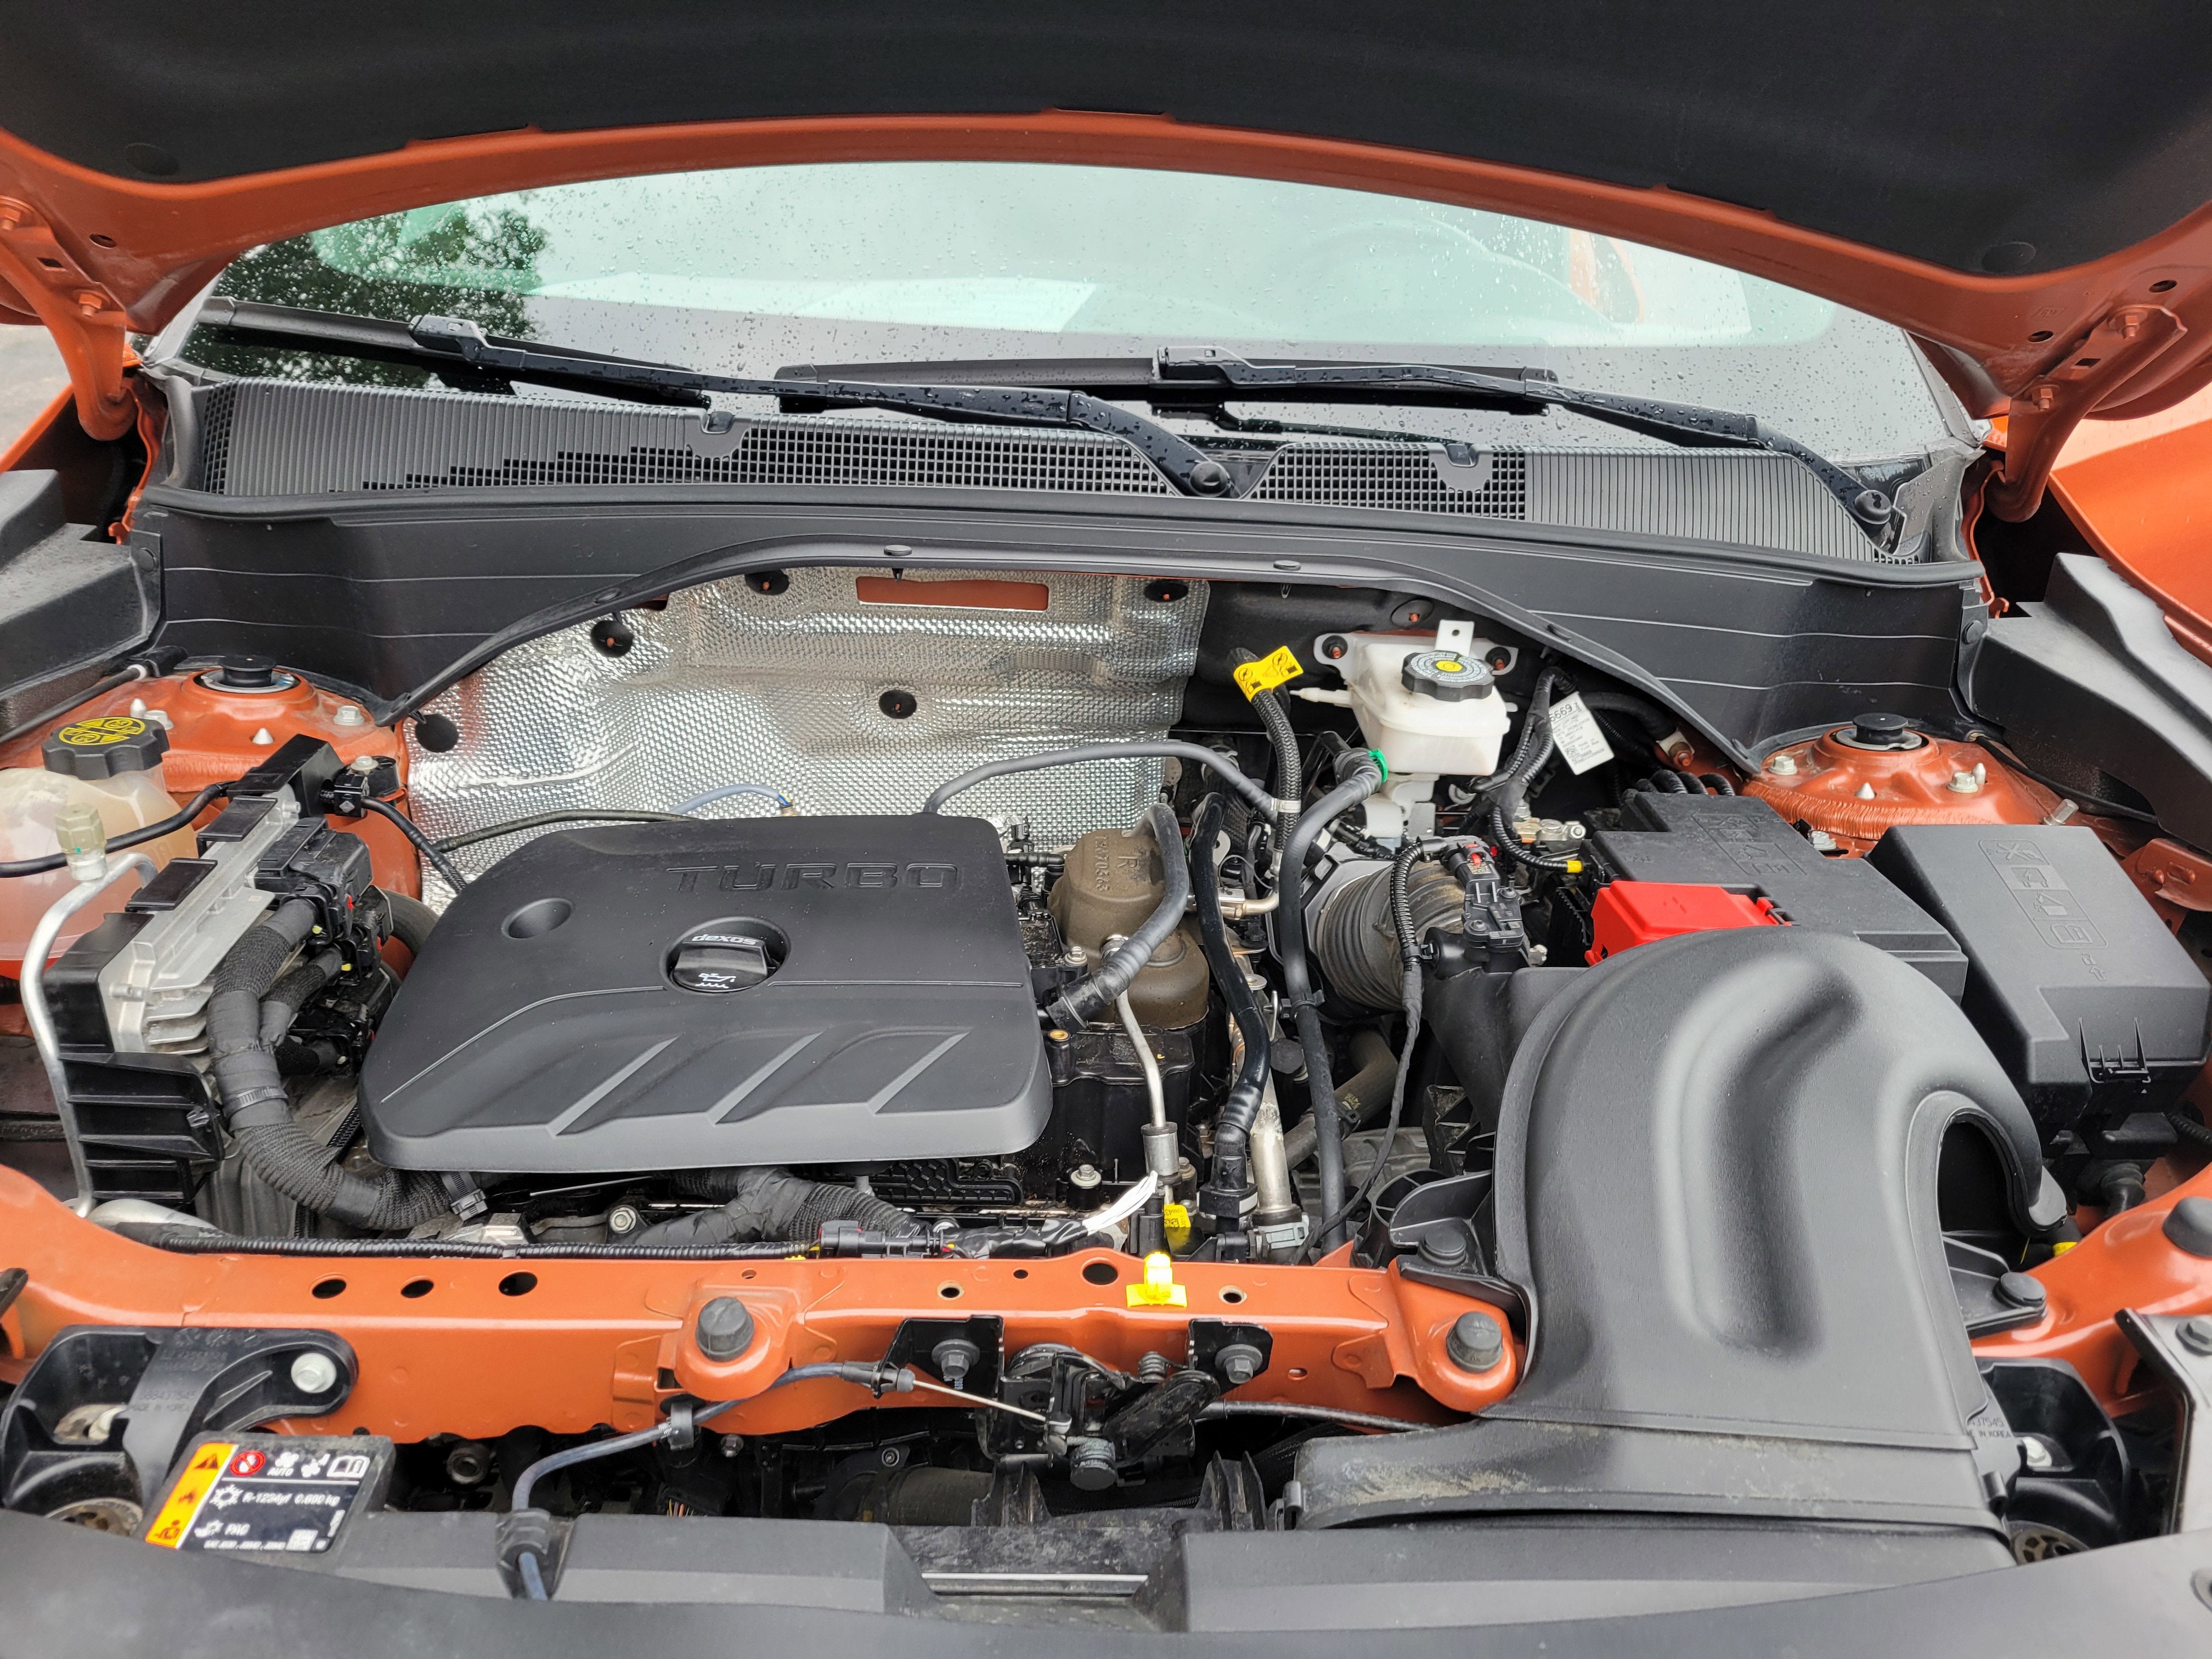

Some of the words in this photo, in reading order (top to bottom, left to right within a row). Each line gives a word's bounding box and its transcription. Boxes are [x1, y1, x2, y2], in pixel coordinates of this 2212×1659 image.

[666, 862, 958, 893] TURBO
[691, 934, 759, 946] dexos
[267, 1468, 294, 1477] AUTO
